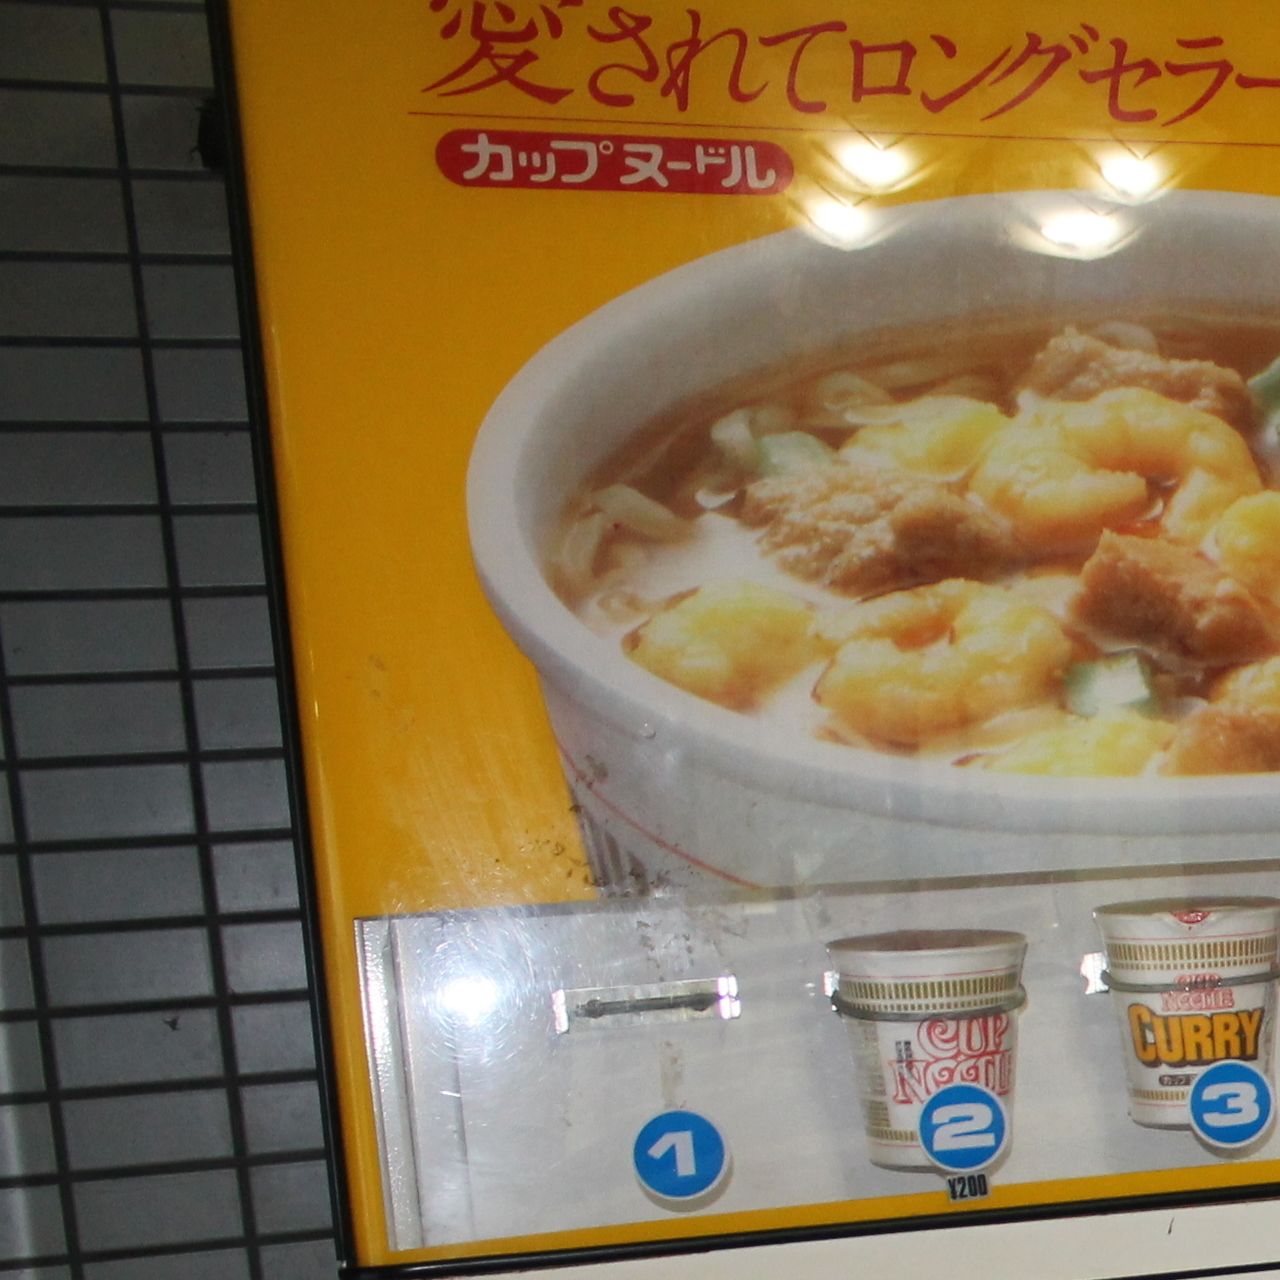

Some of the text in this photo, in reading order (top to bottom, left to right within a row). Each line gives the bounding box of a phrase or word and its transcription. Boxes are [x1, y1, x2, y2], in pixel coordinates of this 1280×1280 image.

[917, 1012, 1010, 1060] CUP
[1127, 1002, 1265, 1067] CURRY
[929, 1101, 996, 1152] 2
[1201, 1080, 1262, 1127] 3
[648, 1130, 697, 1177] 1
[947, 1173, 988, 1200] ¥200
